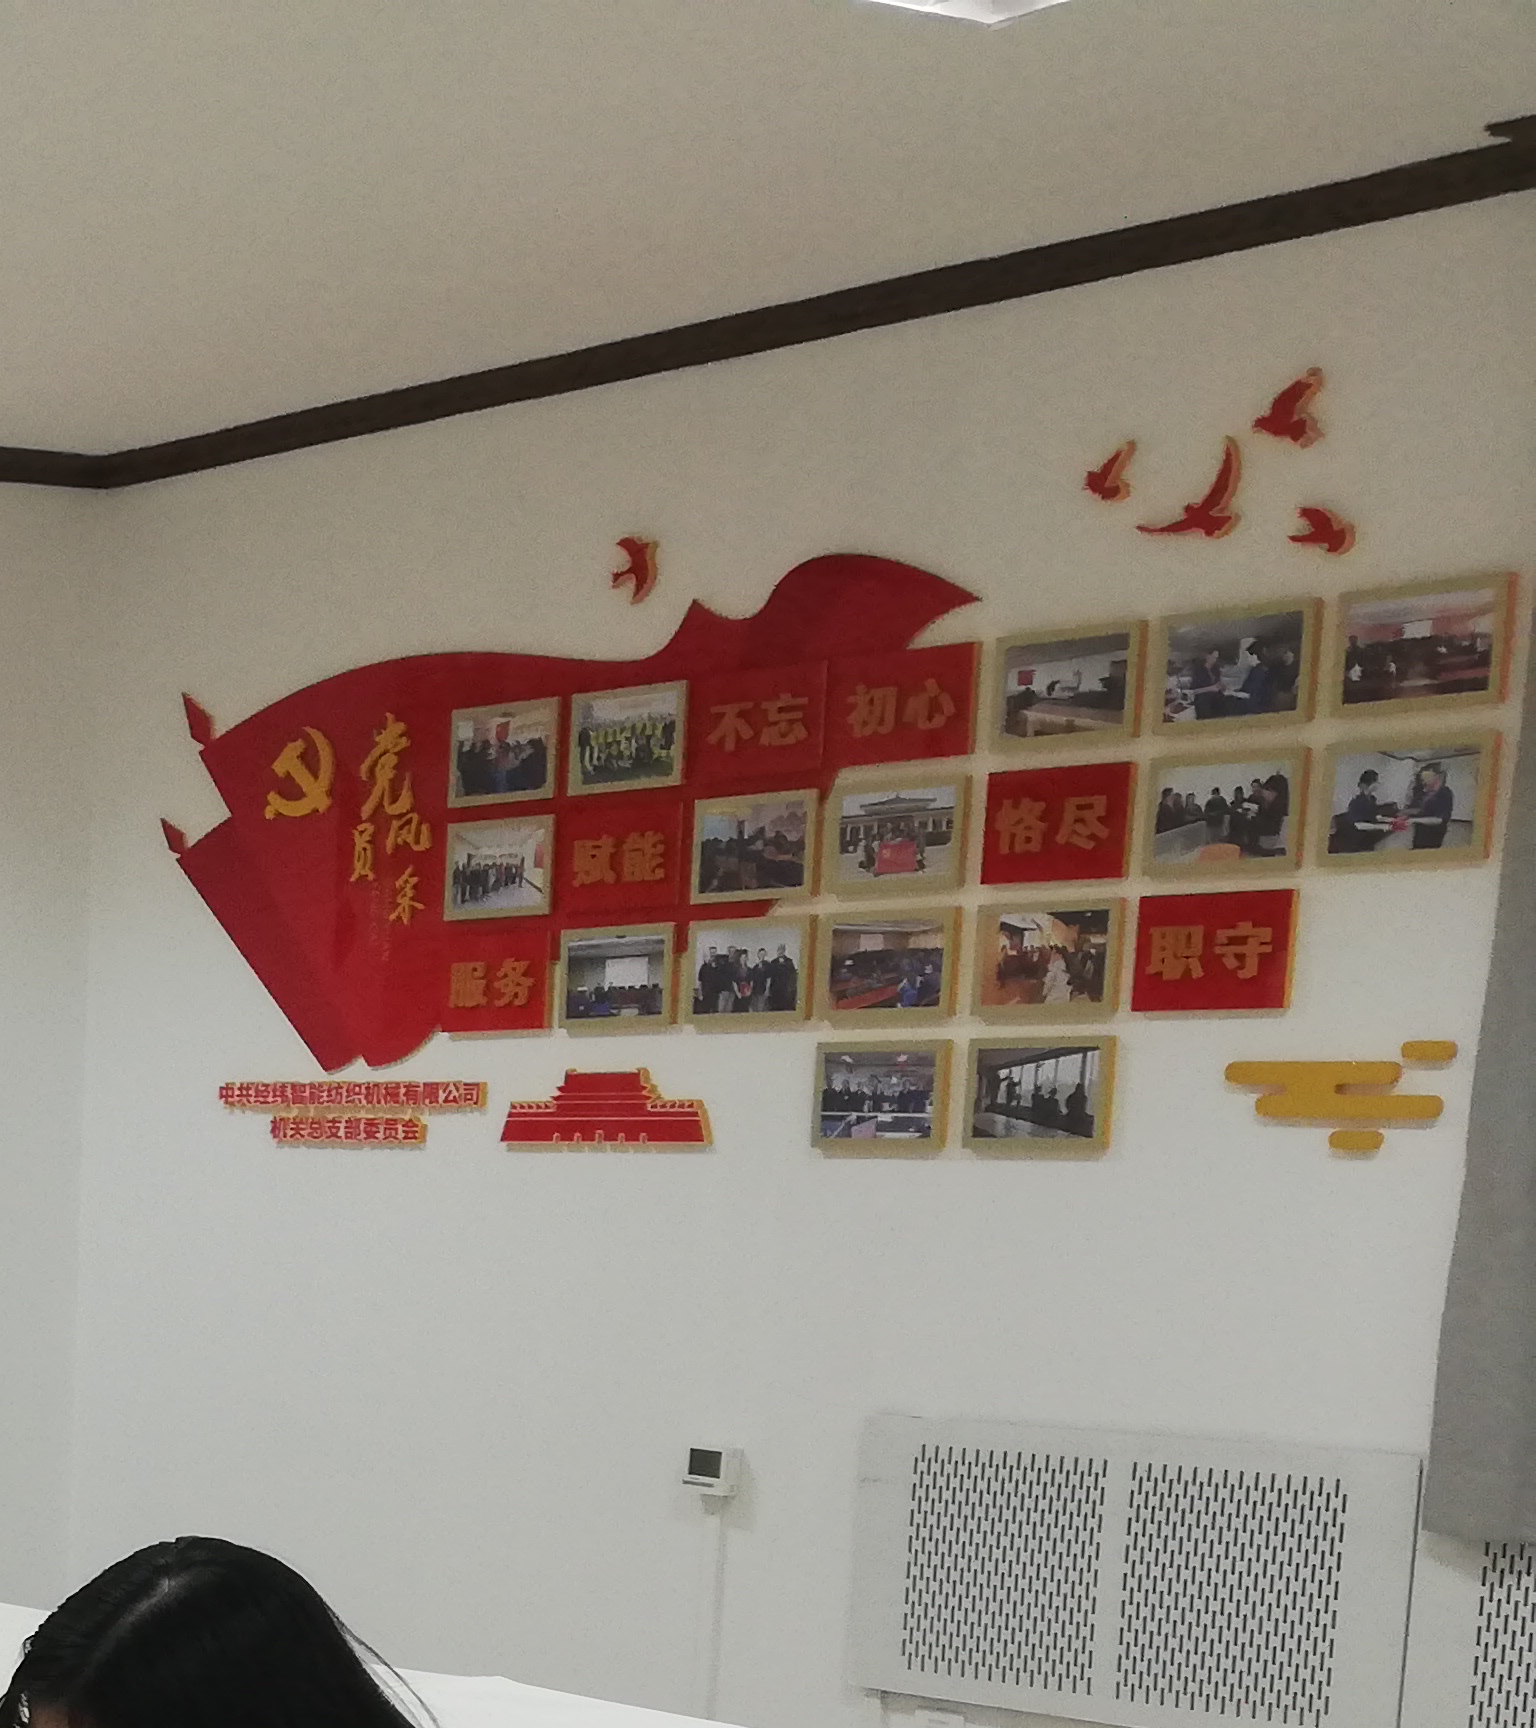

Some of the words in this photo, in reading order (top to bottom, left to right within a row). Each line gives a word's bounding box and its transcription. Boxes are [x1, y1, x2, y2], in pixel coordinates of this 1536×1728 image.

[708, 692, 809, 751] 不忘
[847, 678, 956, 738] 初心
[995, 795, 1110, 855] 恪尽
[573, 830, 666, 888] 赋能
[1145, 920, 1273, 981] 职守
[448, 957, 535, 1009] 服务
[218, 1081, 481, 1107] 中共经纬智能纺织机械有限公司
[270, 1115, 420, 1142] 机关总支部委员会
